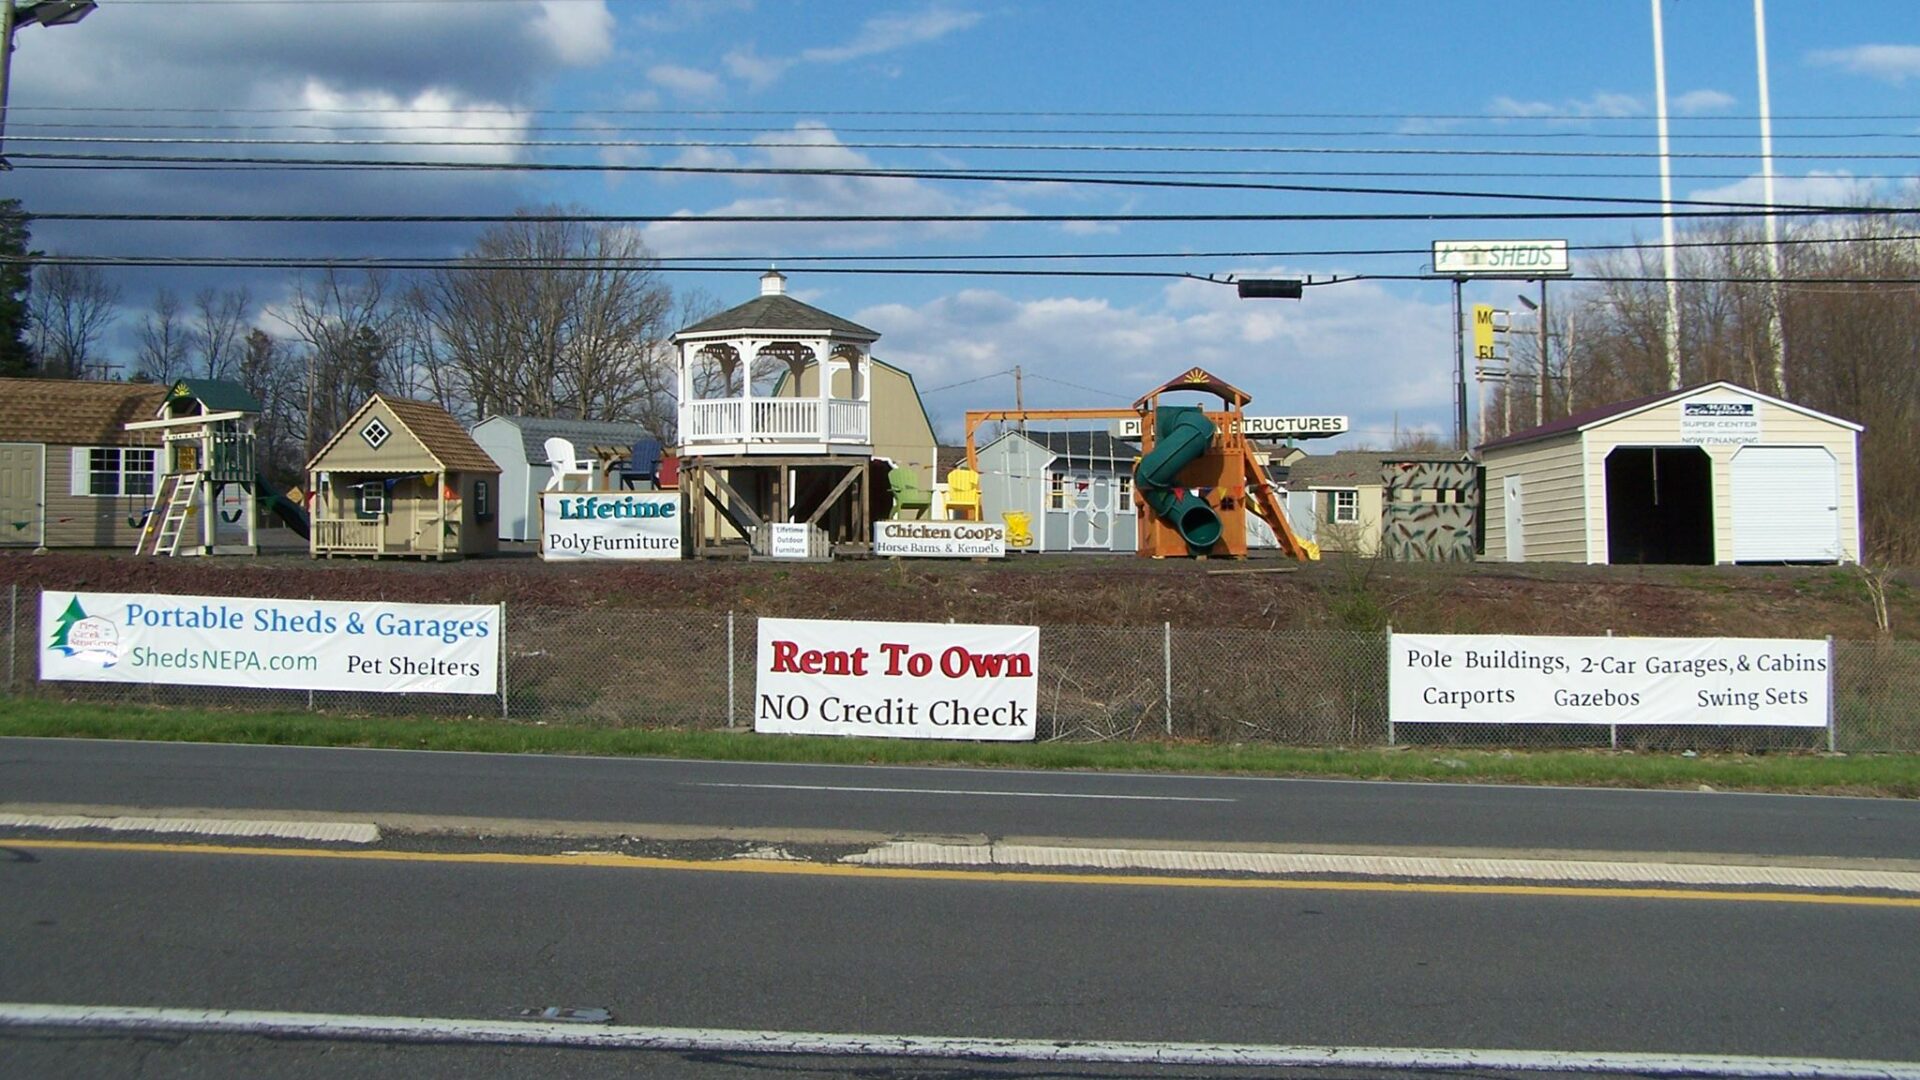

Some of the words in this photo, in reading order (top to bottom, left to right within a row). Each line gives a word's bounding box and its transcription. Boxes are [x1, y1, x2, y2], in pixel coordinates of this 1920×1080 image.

[1488, 245, 1552, 266] SHEDS
[1707, 436, 1758, 444] FINANCING
[559, 496, 676, 520] Lifetime
[885, 524, 951, 539] Chicken
[877, 543, 908, 552] Horse
[911, 543, 940, 552] Barns
[945, 543, 953, 552] &
[958, 543, 1000, 553] Kennels
[126, 604, 244, 629] Portable
[254, 608, 337, 633] Sheds
[346, 612, 365, 634] &
[376, 613, 489, 644] Garages
[131, 646, 317, 671] ShedsNEPA.com
[347, 655, 382, 674] Pet
[389, 656, 480, 677] Shelters
[770, 640, 869, 676] Rent
[880, 643, 933, 677] To
[940, 646, 1033, 678] Own
[1407, 650, 1452, 668] Pole
[1465, 650, 1570, 674] Buildings,
[1581, 657, 1636, 674] 2-Car
[1646, 656, 1734, 677] Garages,
[1736, 654, 1750, 672] &
[1757, 653, 1827, 672] Cabins
[760, 694, 808, 721] NO
[820, 697, 919, 725] Credit
[929, 699, 1028, 726] Check
[1423, 687, 1515, 709] Carports
[1554, 689, 1640, 707] Gazebos
[1697, 688, 1759, 711] Swing
[1765, 687, 1808, 705] Sets
